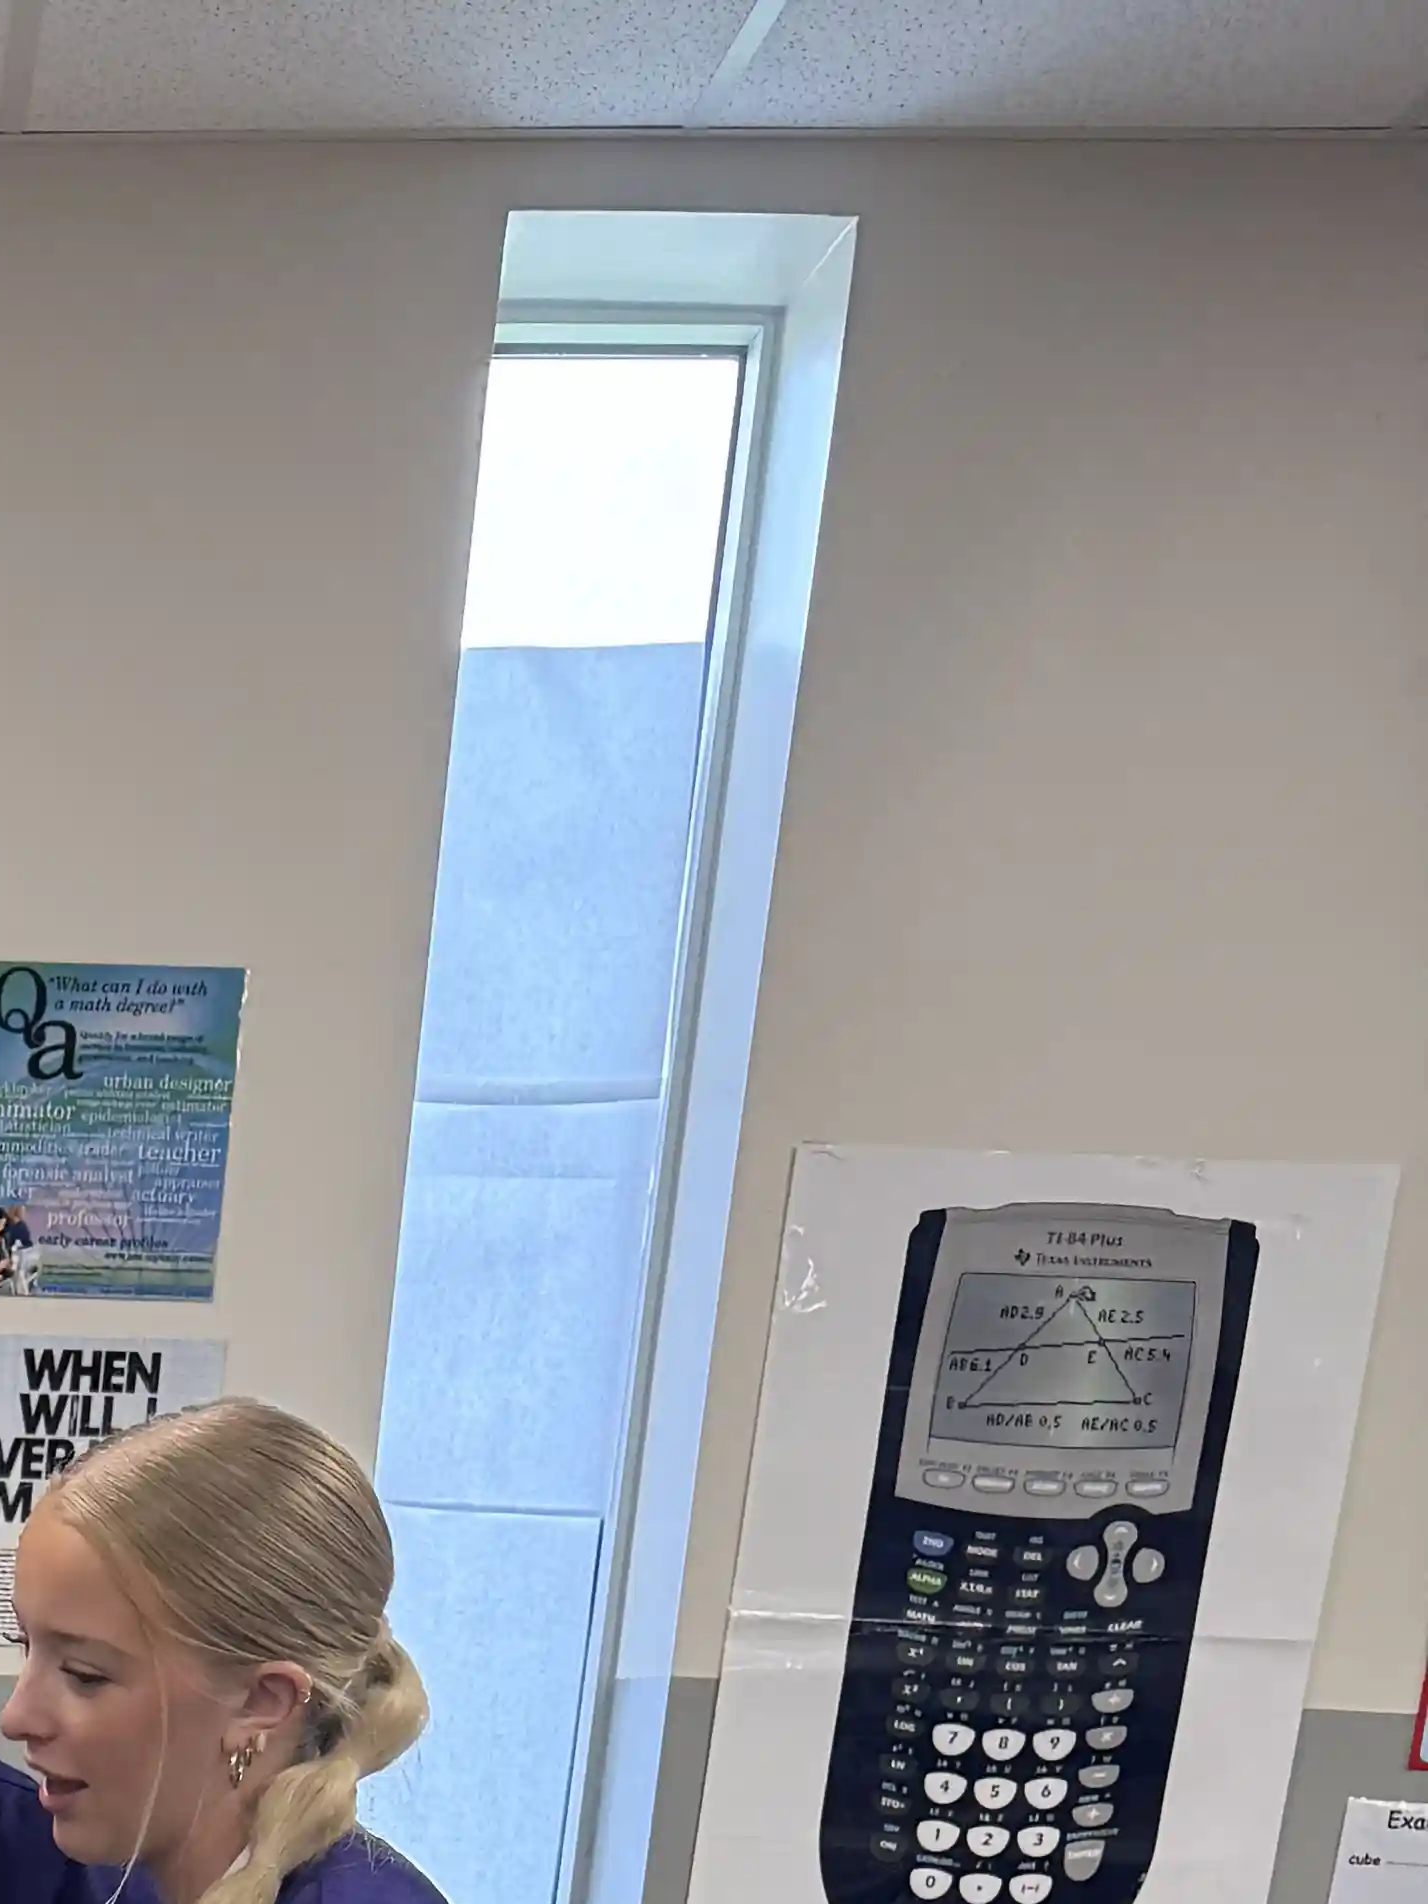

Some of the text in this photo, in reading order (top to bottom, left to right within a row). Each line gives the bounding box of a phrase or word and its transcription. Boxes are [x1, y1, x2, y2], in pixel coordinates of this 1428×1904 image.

[101, 982, 130, 996] can
[147, 979, 168, 996] do
[172, 979, 208, 998] with
[54, 997, 112, 1013] a math
[103, 1074, 153, 1090] urban
[158, 1075, 234, 1095] designer
[138, 1139, 221, 1164] teacher
[1, 1163, 135, 1184] forensic analyst
[132, 1189, 196, 1205] actuary
[47, 1208, 131, 1228] professor
[38, 1234, 72, 1249] early
[119, 1235, 169, 1249] profiles
[1090, 1232, 1124, 1248] Plus
[1073, 1253, 1153, 1268] INSTRUMENTS
[1055, 1285, 1064, 1298] A
[1098, 1310, 1145, 1324] AE 2.5
[1020, 1353, 1028, 1366] D
[1088, 1351, 1097, 1364] E
[23, 1348, 162, 1394] WHEN
[1144, 1393, 1153, 1406] C
[19, 1393, 123, 1437] WILL
[1081, 1417, 1129, 1432] AE/AC
[1023, 1551, 1042, 1562] DEL
[909, 1572, 942, 1587] ALPHA
[906, 1609, 936, 1624] MATH
[1107, 1619, 1144, 1633] CLEAR
[894, 1720, 916, 1733] LOG
[947, 1731, 958, 1744] 7
[998, 1736, 1009, 1750] 8
[1050, 1736, 1061, 1751] 9
[940, 1780, 950, 1793] 4
[990, 1785, 1000, 1798] 5
[1041, 1784, 1052, 1798] 6
[1387, 1810, 1428, 1831] Exa
[934, 1827, 941, 1841] 1
[982, 1833, 993, 1846] 2
[1033, 1833, 1044, 1846] 3
[1348, 1853, 1382, 1866] cube
[925, 1875, 936, 1888] 0
